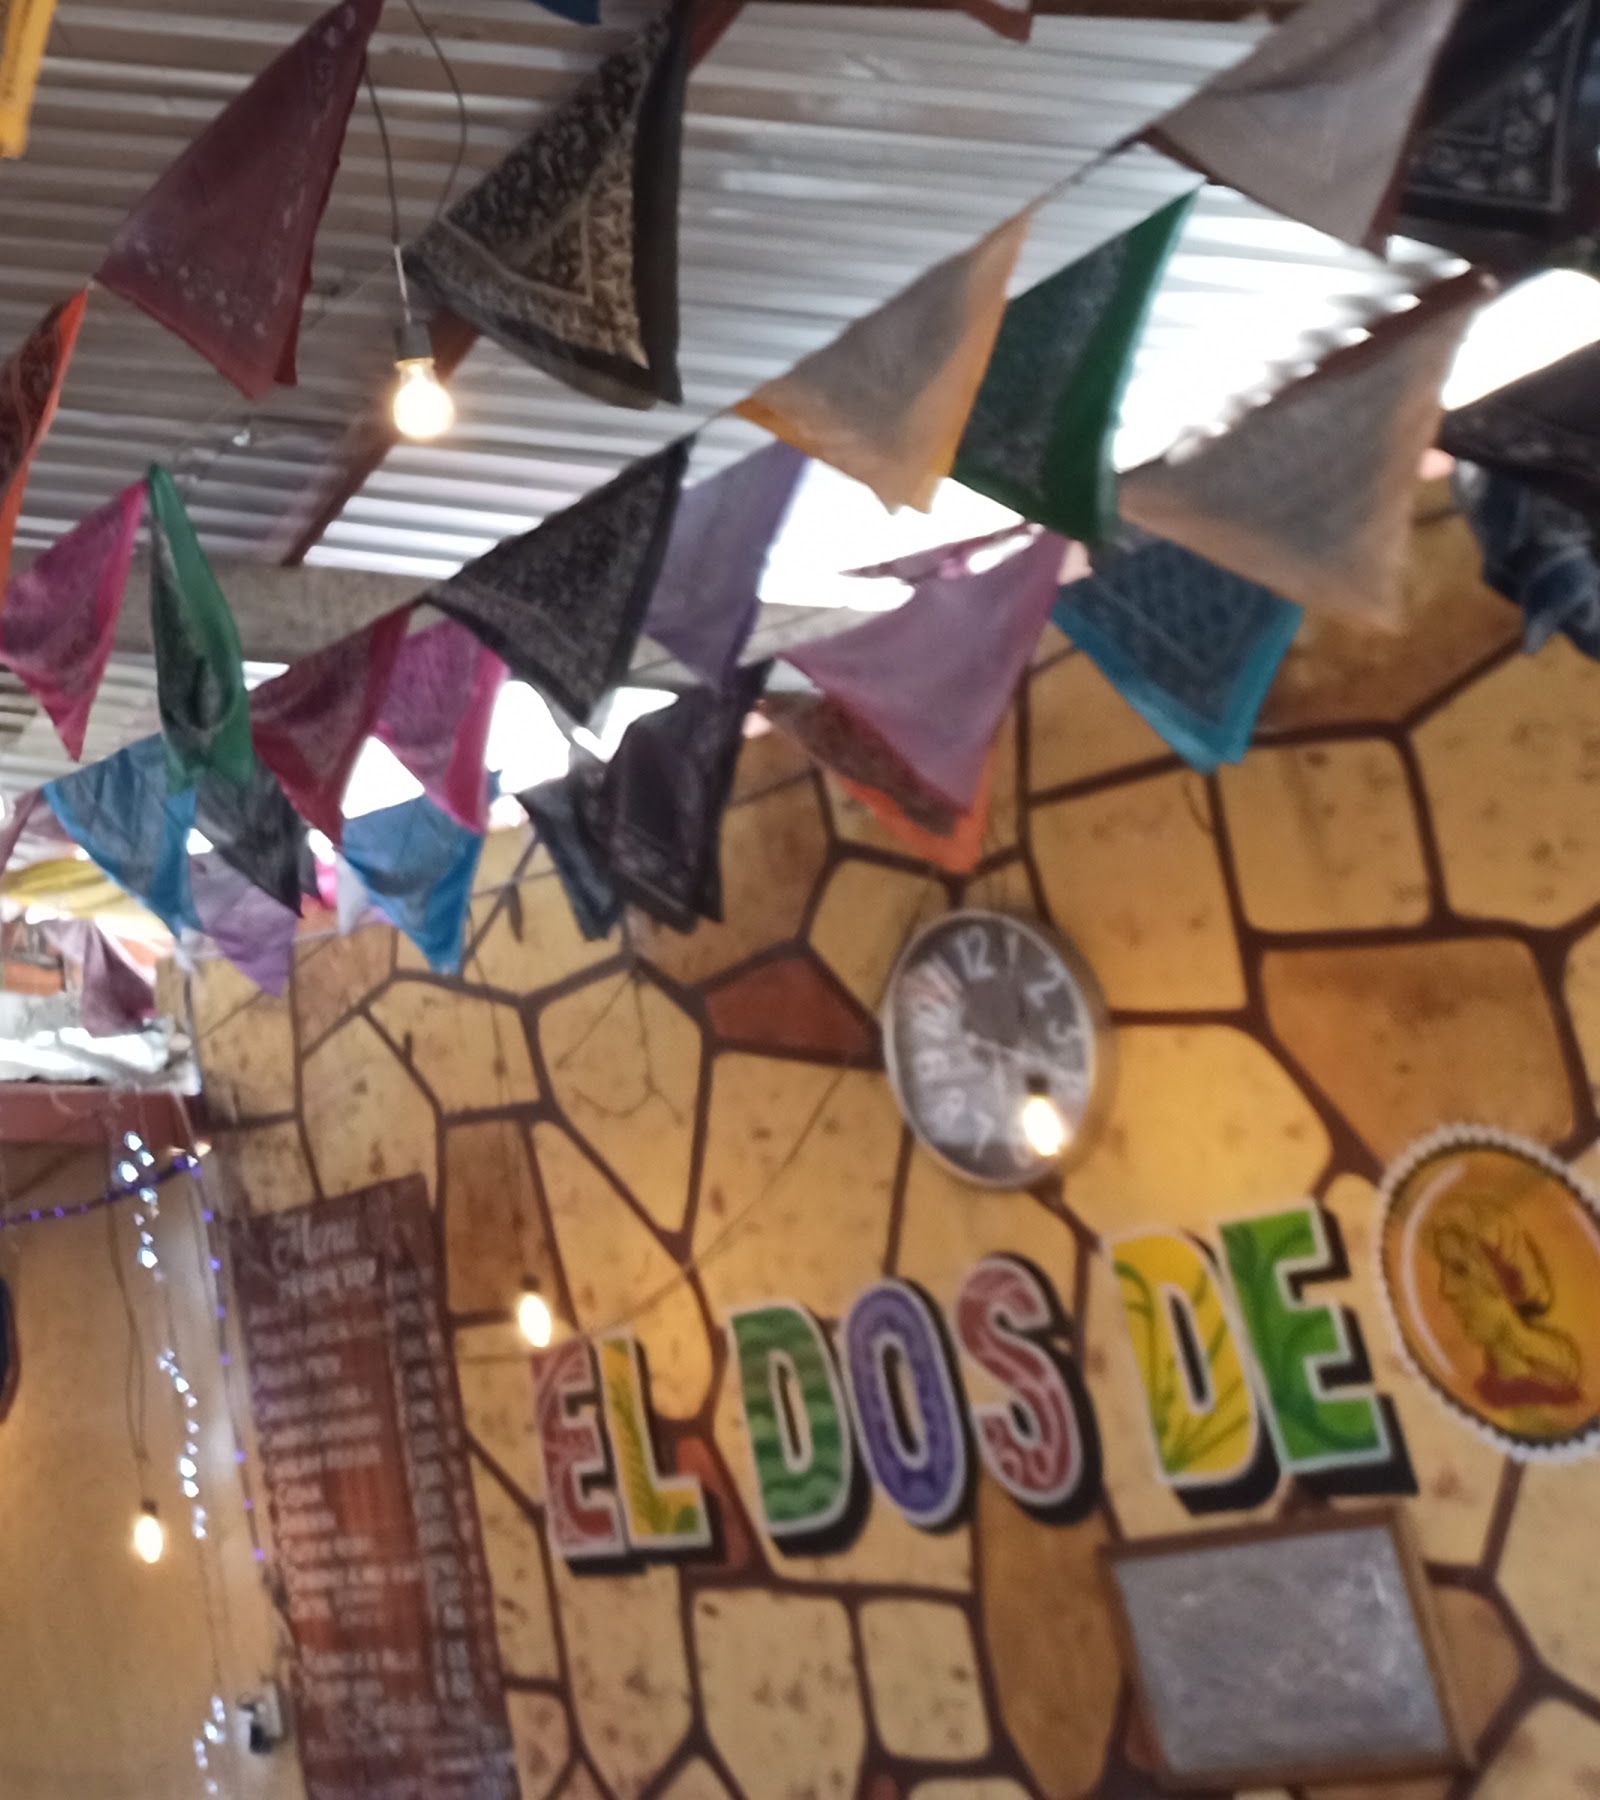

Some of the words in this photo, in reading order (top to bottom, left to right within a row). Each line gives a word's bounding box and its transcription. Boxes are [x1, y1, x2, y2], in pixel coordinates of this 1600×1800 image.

[953, 925, 998, 981] 12
[530, 1327, 712, 1559] EL
[726, 1254, 1086, 1535] DOS
[1100, 1200, 1393, 1488] DE
